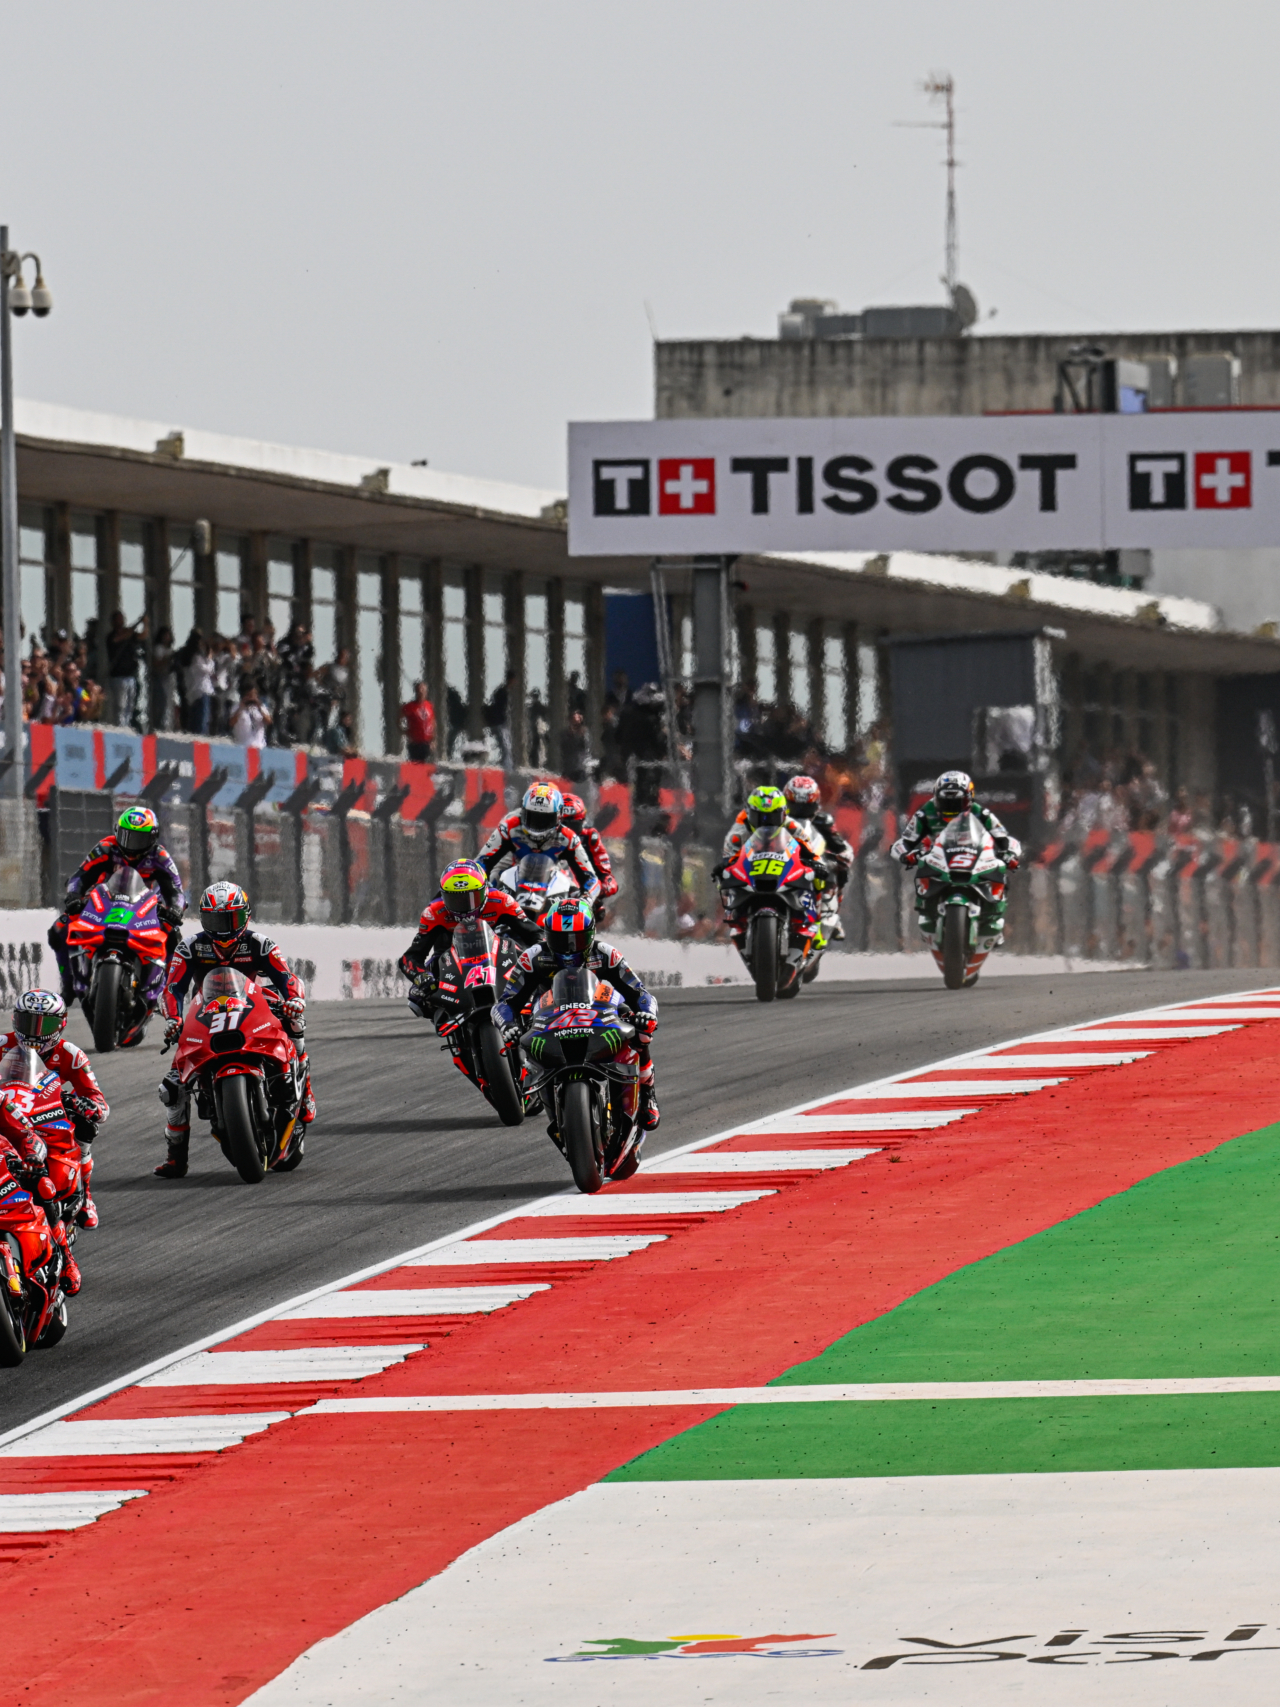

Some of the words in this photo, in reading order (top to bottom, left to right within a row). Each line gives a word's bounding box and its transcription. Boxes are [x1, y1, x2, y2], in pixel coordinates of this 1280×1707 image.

[729, 452, 1078, 516] TISSOT
[749, 859, 786, 877] 36
[516, 892, 545, 911] 25
[104, 907, 136, 925] 21
[134, 918, 157, 929] prima
[464, 965, 497, 989] 41
[560, 1002, 592, 1011] ENEOS
[209, 1010, 242, 1034] 31
[548, 1008, 598, 1030] 42
[554, 1027, 595, 1038] MONSTER
[30, 1108, 64, 1124] Lenovo
[897, 1619, 1280, 1648] visi
